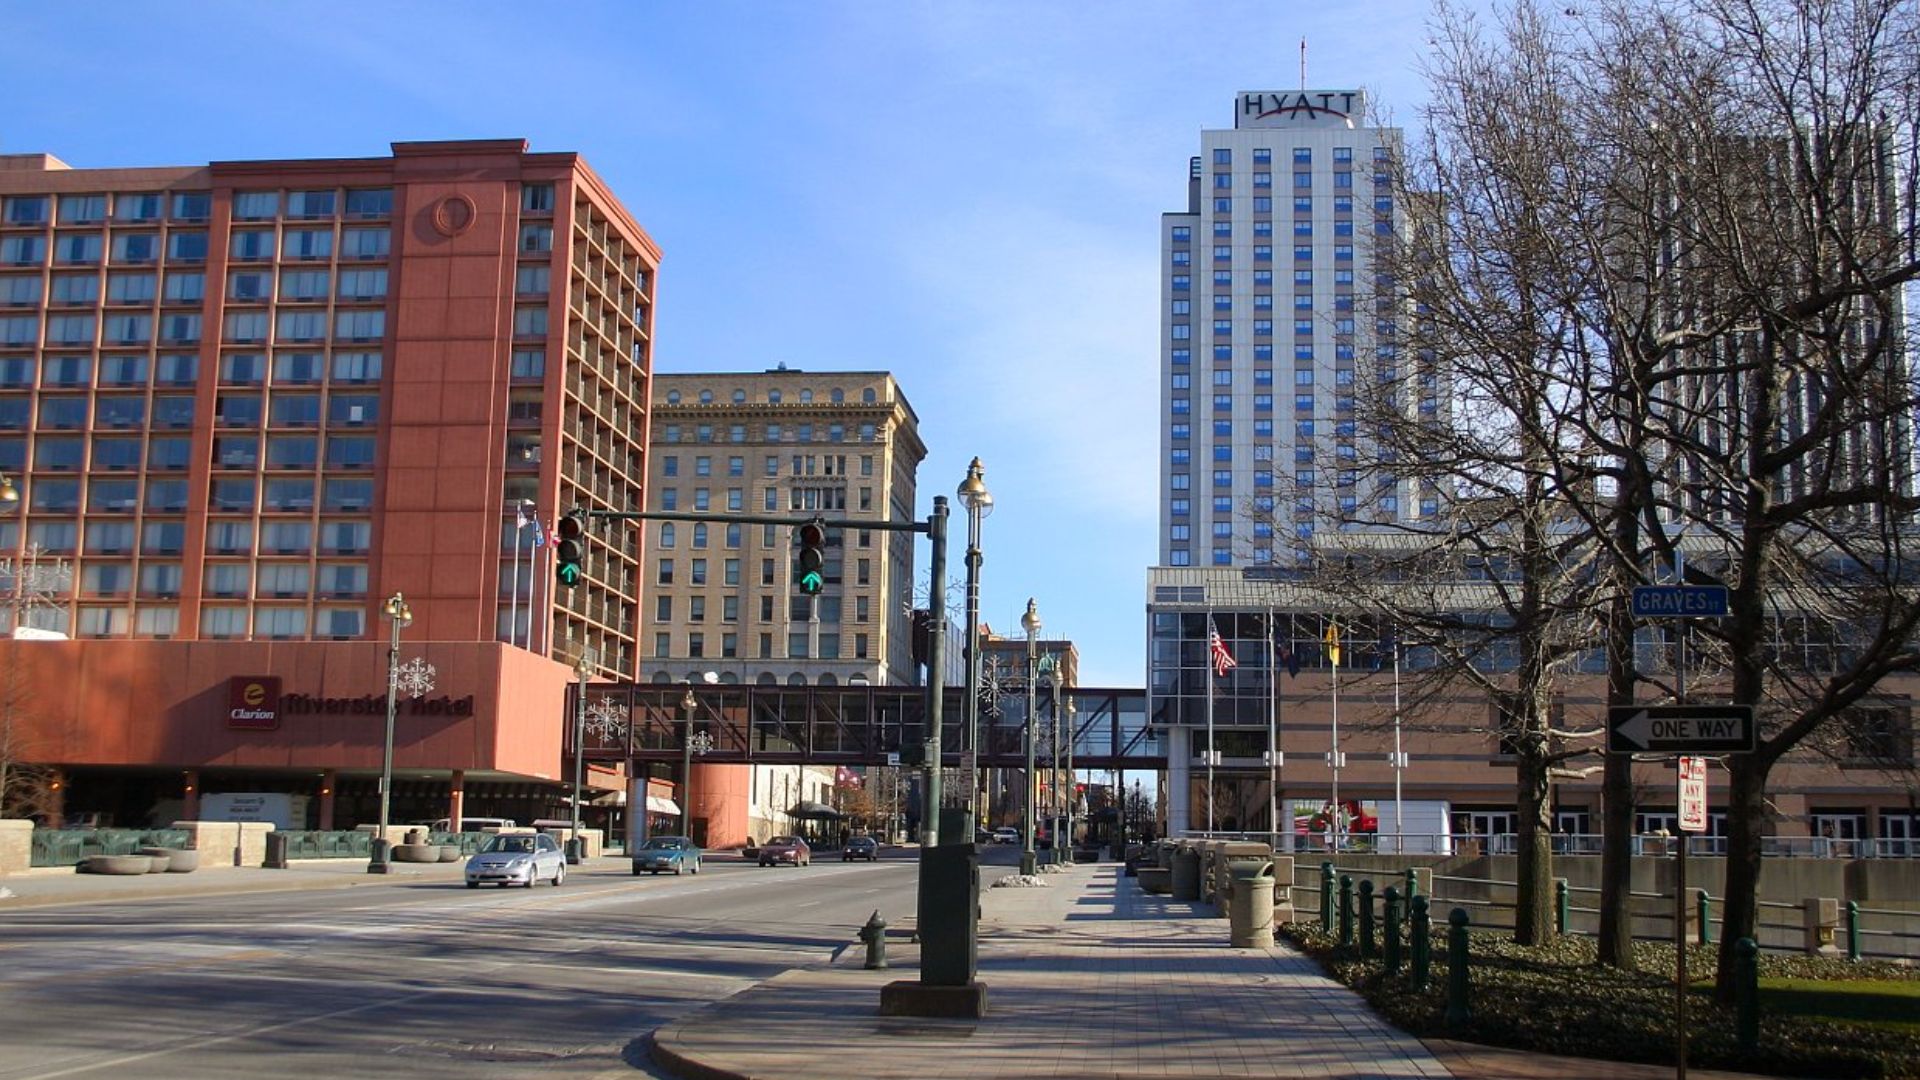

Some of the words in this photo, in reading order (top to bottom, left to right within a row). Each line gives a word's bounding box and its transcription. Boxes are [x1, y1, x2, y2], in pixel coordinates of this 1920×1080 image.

[1245, 93, 1356, 120] HYATT
[1639, 592, 1707, 610] GRAVES
[231, 708, 275, 720] Clarion
[410, 694, 473, 716] Hotel
[1651, 720, 1690, 739] ONE
[1697, 720, 1738, 739] WAY
[1685, 784, 1700, 797] ANY
[1683, 799, 1702, 814] TIME
